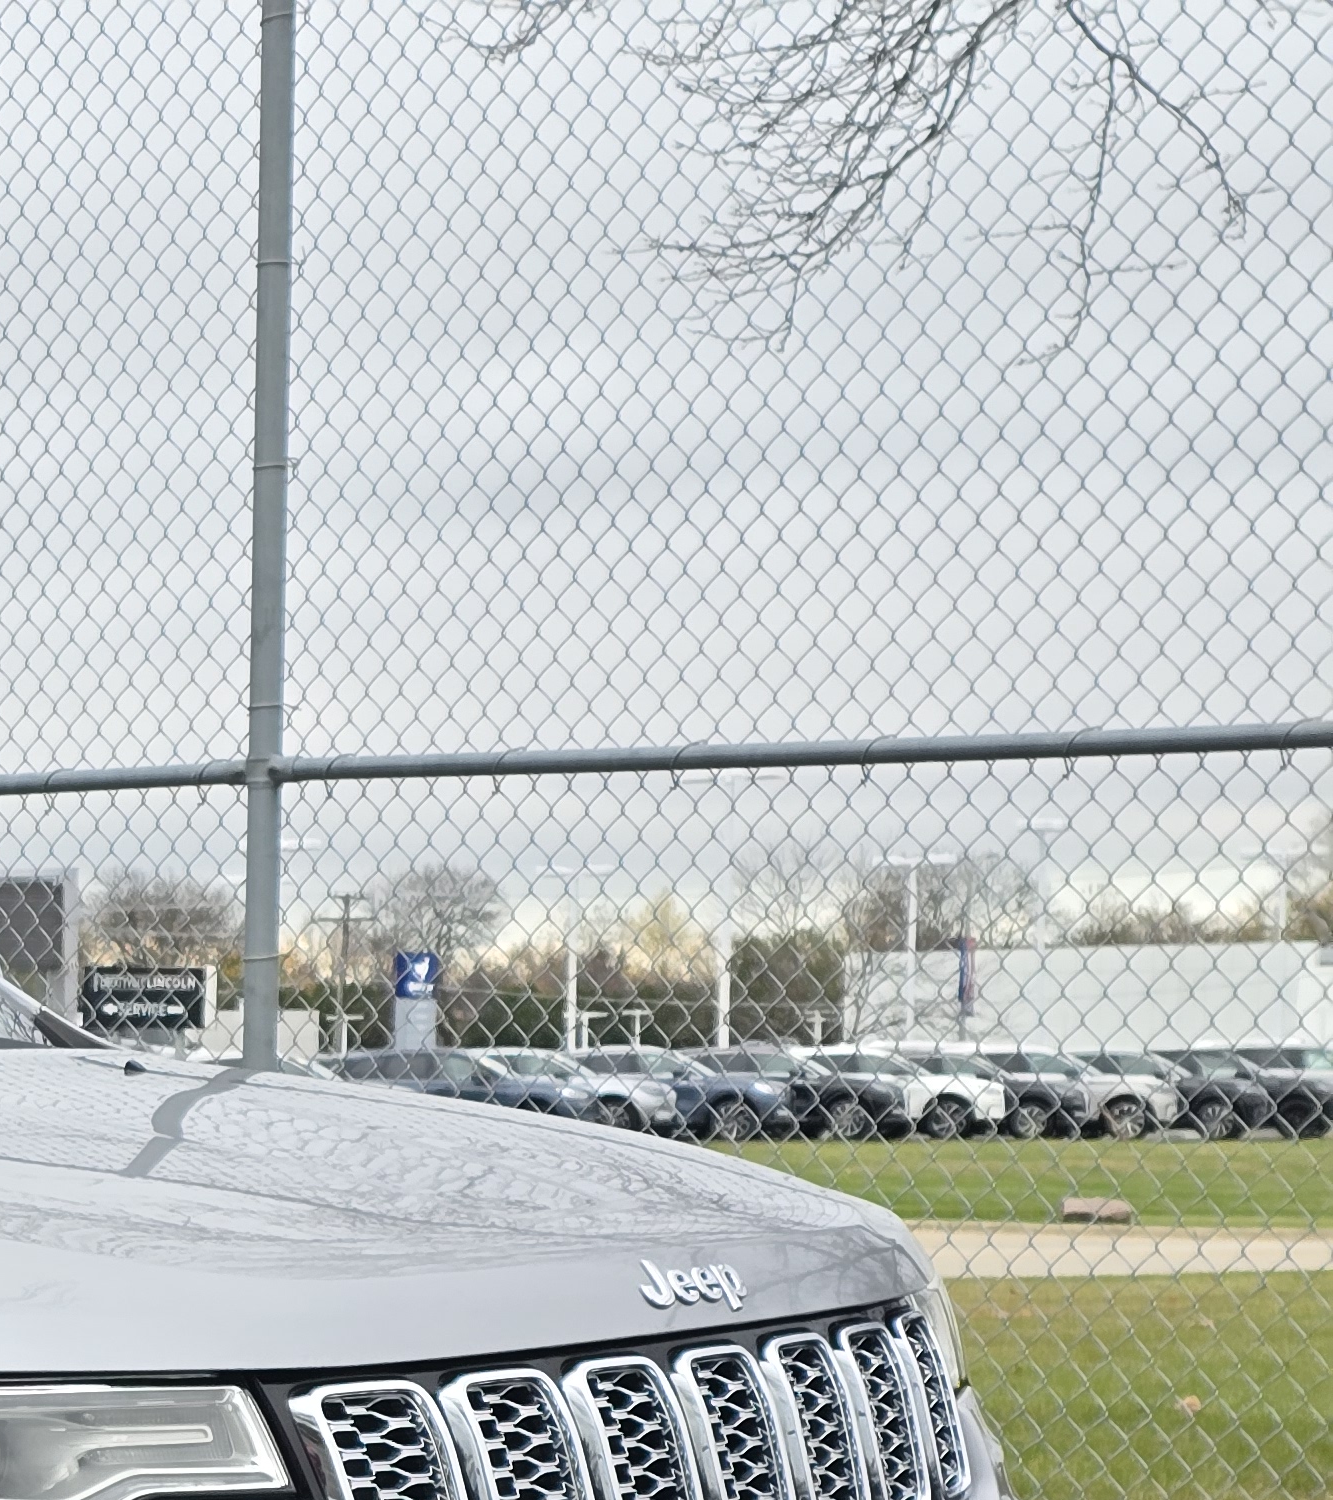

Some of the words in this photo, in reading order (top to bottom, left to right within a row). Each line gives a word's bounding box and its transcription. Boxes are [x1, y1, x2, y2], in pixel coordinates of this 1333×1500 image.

[146, 977, 196, 990] LINCOLN
[118, 1002, 167, 1017] SERVICE
[638, 1258, 748, 1312] Jeep
